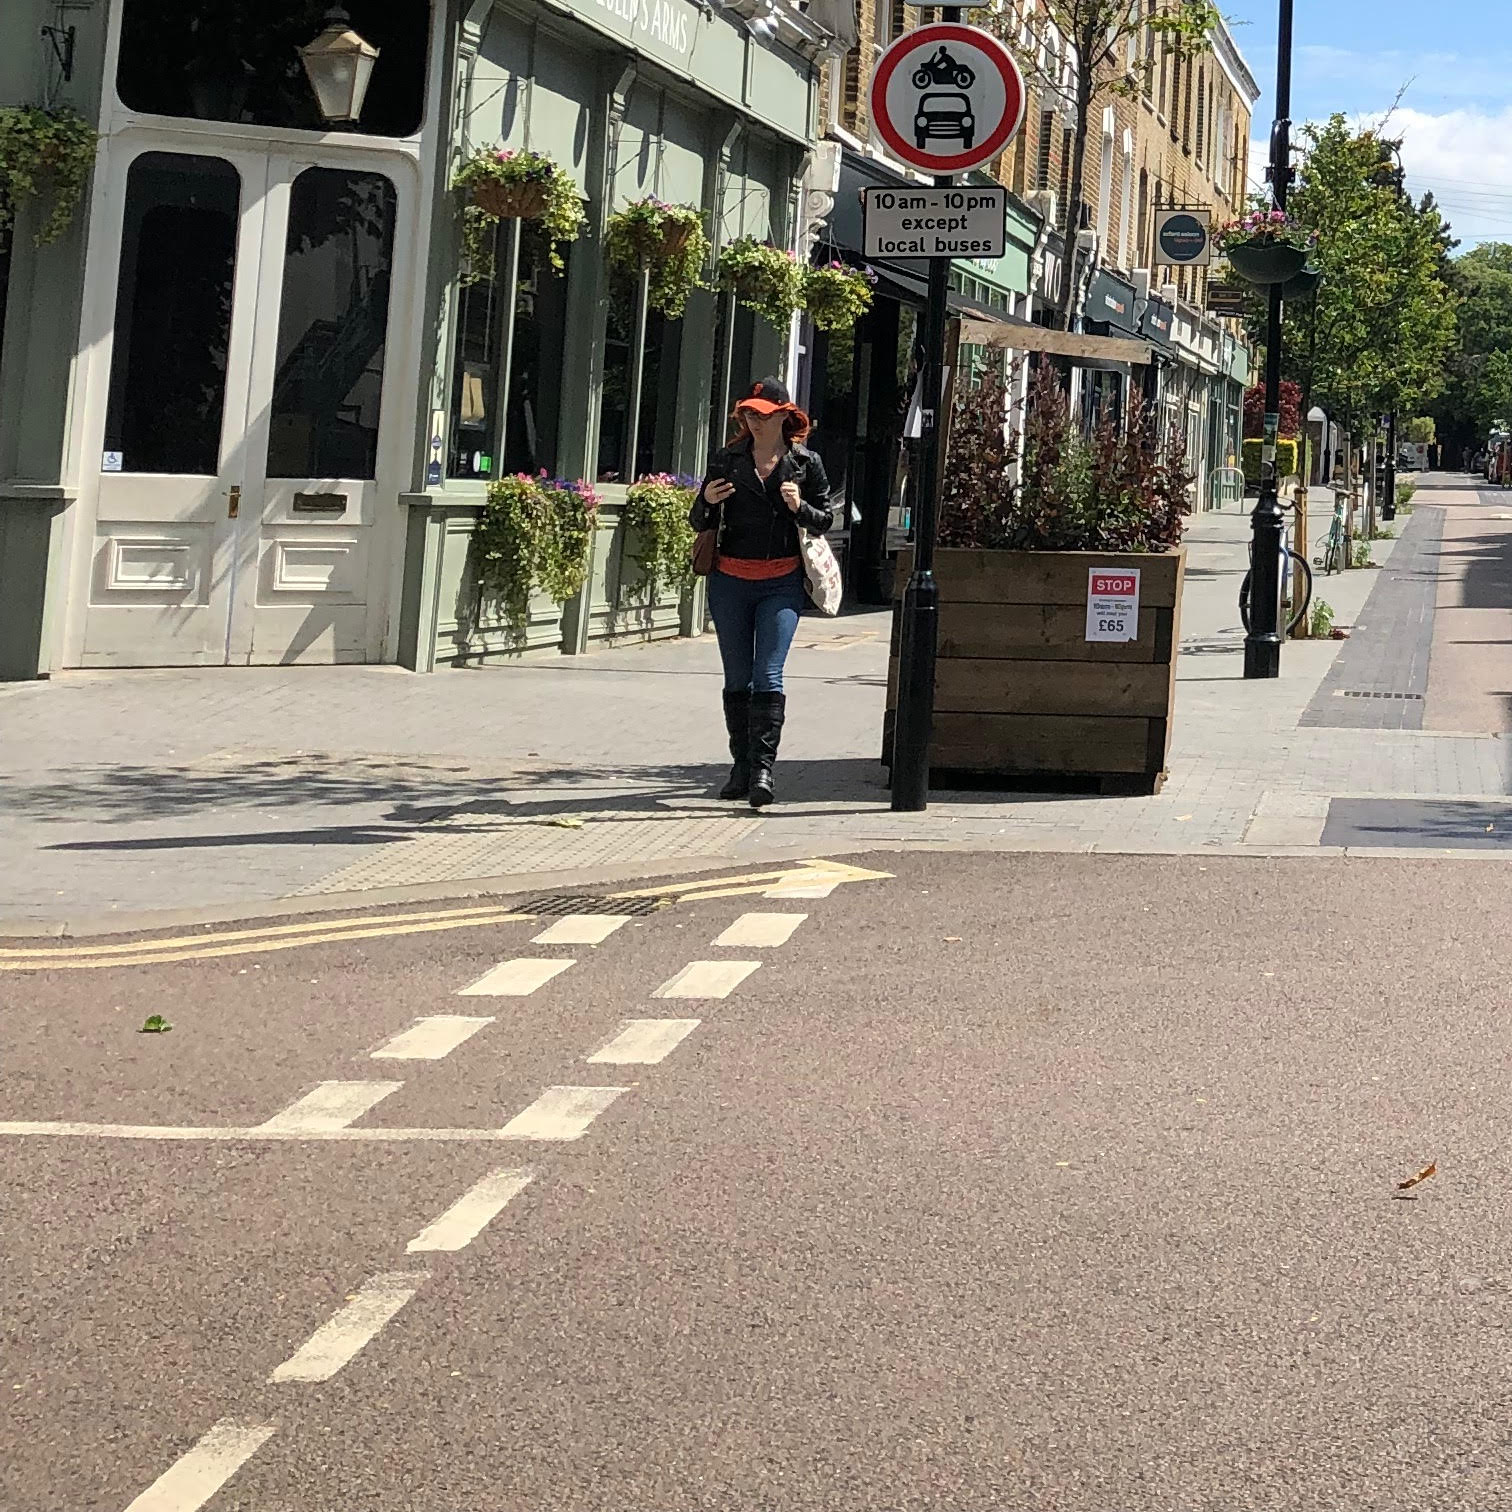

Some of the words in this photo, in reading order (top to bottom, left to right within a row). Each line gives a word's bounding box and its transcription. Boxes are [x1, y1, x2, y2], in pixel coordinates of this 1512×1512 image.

[902, 215, 967, 232] except
[878, 237, 925, 252] local
[935, 237, 992, 252] buses
[1097, 579, 1132, 591] STOP
[1098, 619, 1124, 633] £65
